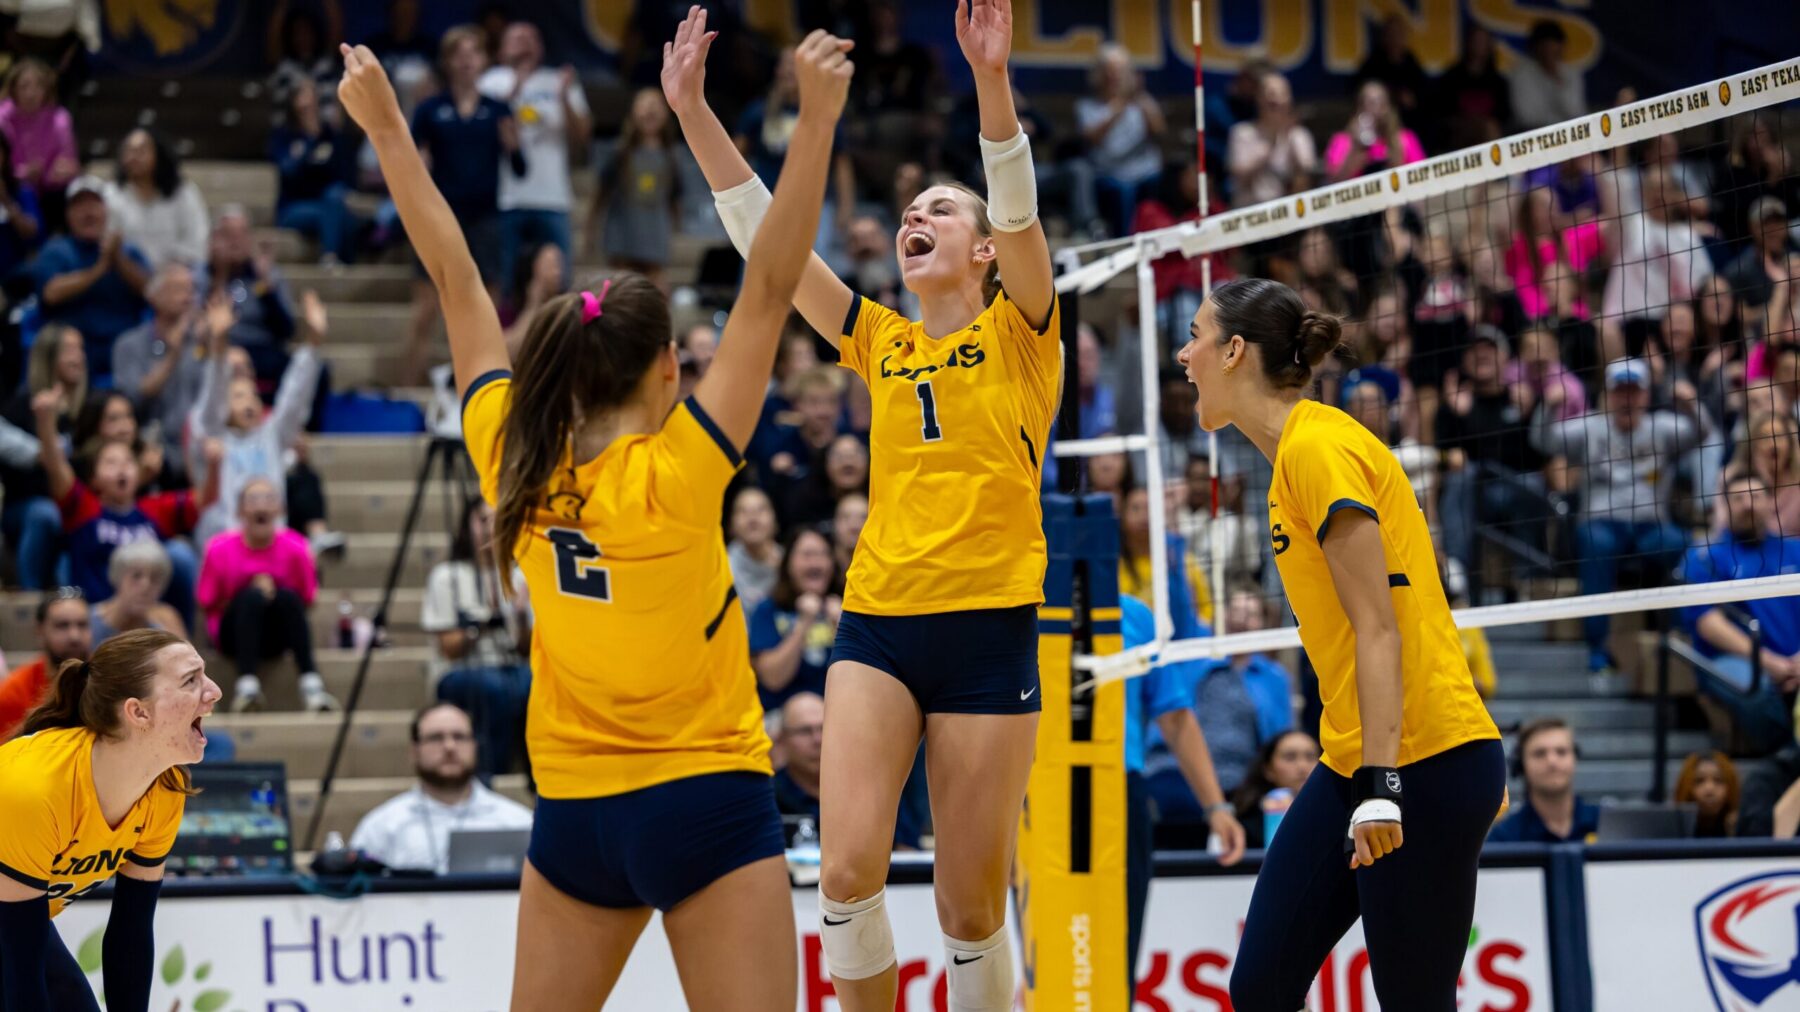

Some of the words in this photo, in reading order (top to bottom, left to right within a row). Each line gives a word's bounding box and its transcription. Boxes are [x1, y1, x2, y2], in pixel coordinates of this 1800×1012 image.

[1741, 74, 1769, 97] EAST
[1621, 109, 1647, 128] EAST
[1649, 97, 1684, 120] TEXAS
[1687, 91, 1710, 111] A&M
[1510, 138, 1534, 158] EAST
[1537, 129, 1568, 150] TEXAS
[1407, 167, 1430, 184] EAST
[1432, 158, 1461, 177] TEXAS
[915, 380, 943, 443] 1
[262, 915, 447, 986] Hunt
